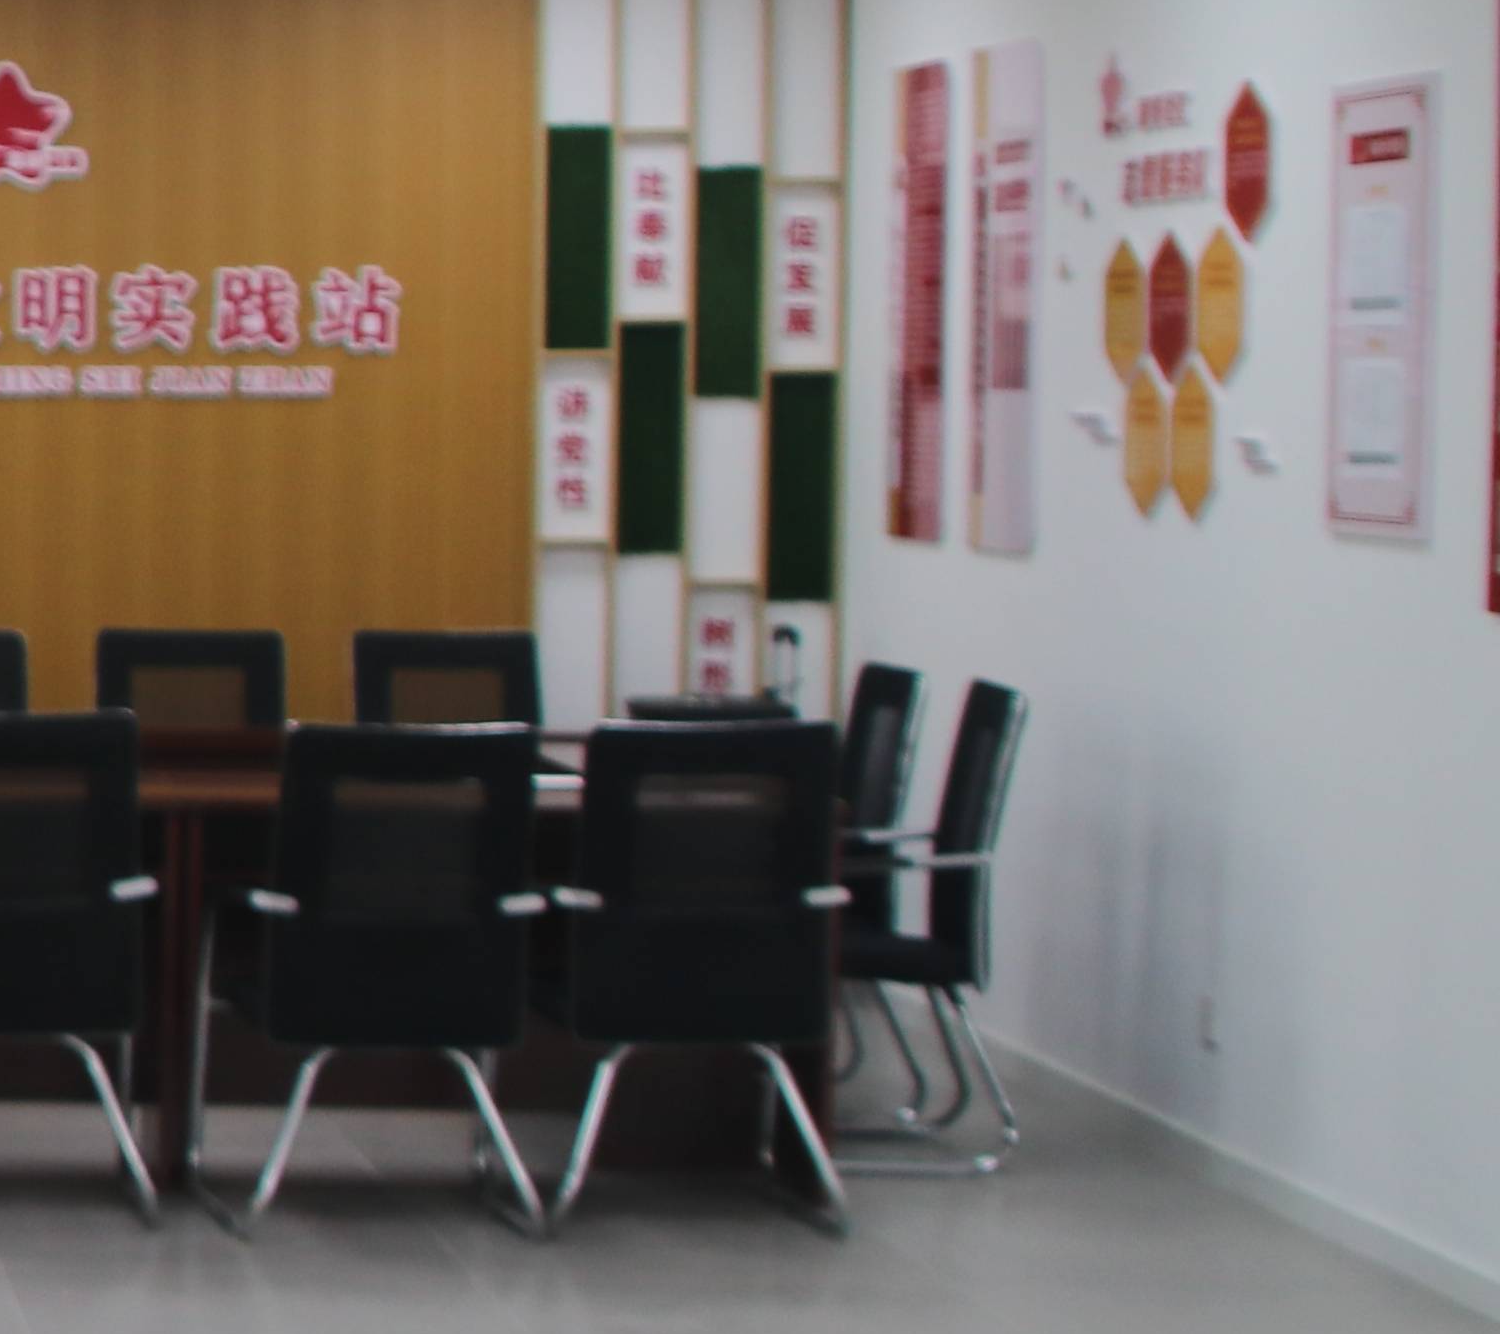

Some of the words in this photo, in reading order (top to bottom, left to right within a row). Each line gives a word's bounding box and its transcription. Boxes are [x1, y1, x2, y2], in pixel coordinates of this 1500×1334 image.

[780, 215, 818, 338] 促发展
[78, 365, 143, 398] SHI
[149, 365, 232, 398] JIAN
[237, 365, 333, 398] ZHAN
[697, 616, 736, 694] 树形
